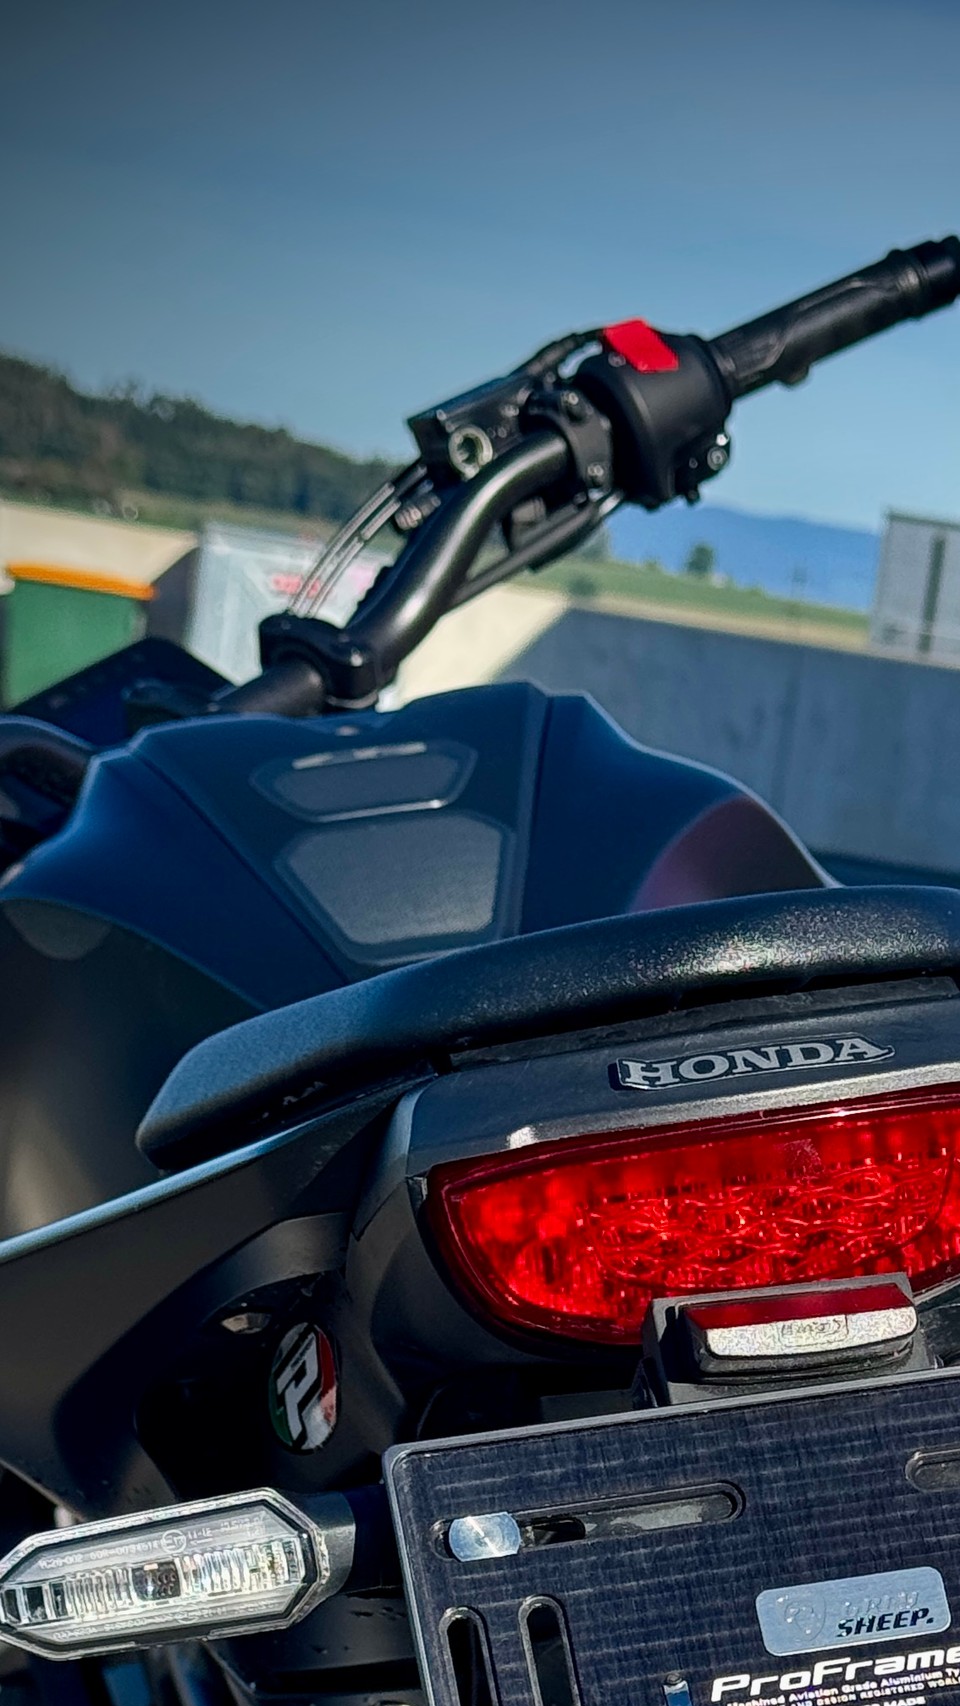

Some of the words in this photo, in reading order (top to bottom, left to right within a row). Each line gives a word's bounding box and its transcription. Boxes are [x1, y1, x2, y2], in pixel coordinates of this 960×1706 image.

[622, 1037, 890, 1085] HONDA
[817, 1693, 857, 1706] DESIGN
[860, 1682, 925, 1699] REGISTERED
